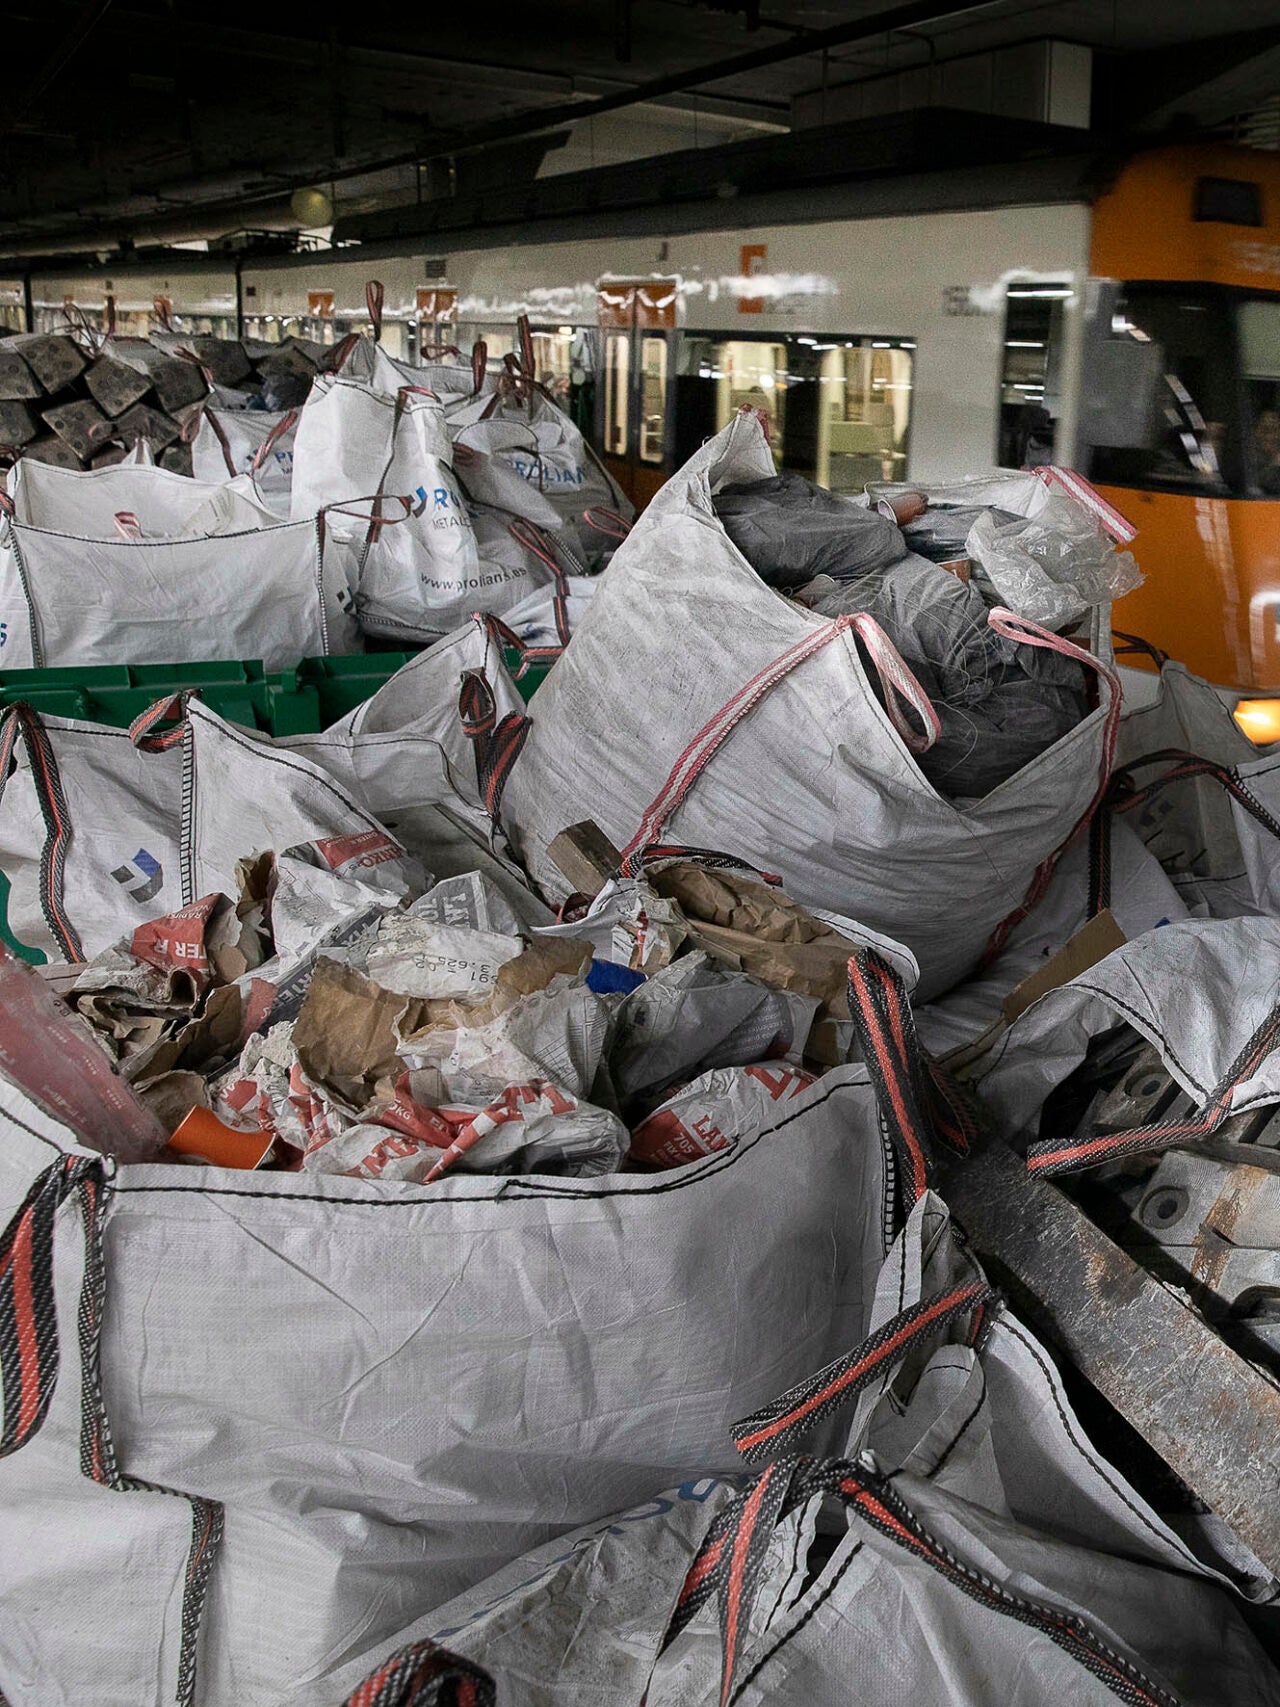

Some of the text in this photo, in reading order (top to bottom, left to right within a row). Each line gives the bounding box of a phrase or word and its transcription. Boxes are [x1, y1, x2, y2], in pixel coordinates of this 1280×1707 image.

[420, 566, 528, 592] www.prolians.es
[418, 898, 440, 924] 70
[673, 1131, 695, 1155] 705
